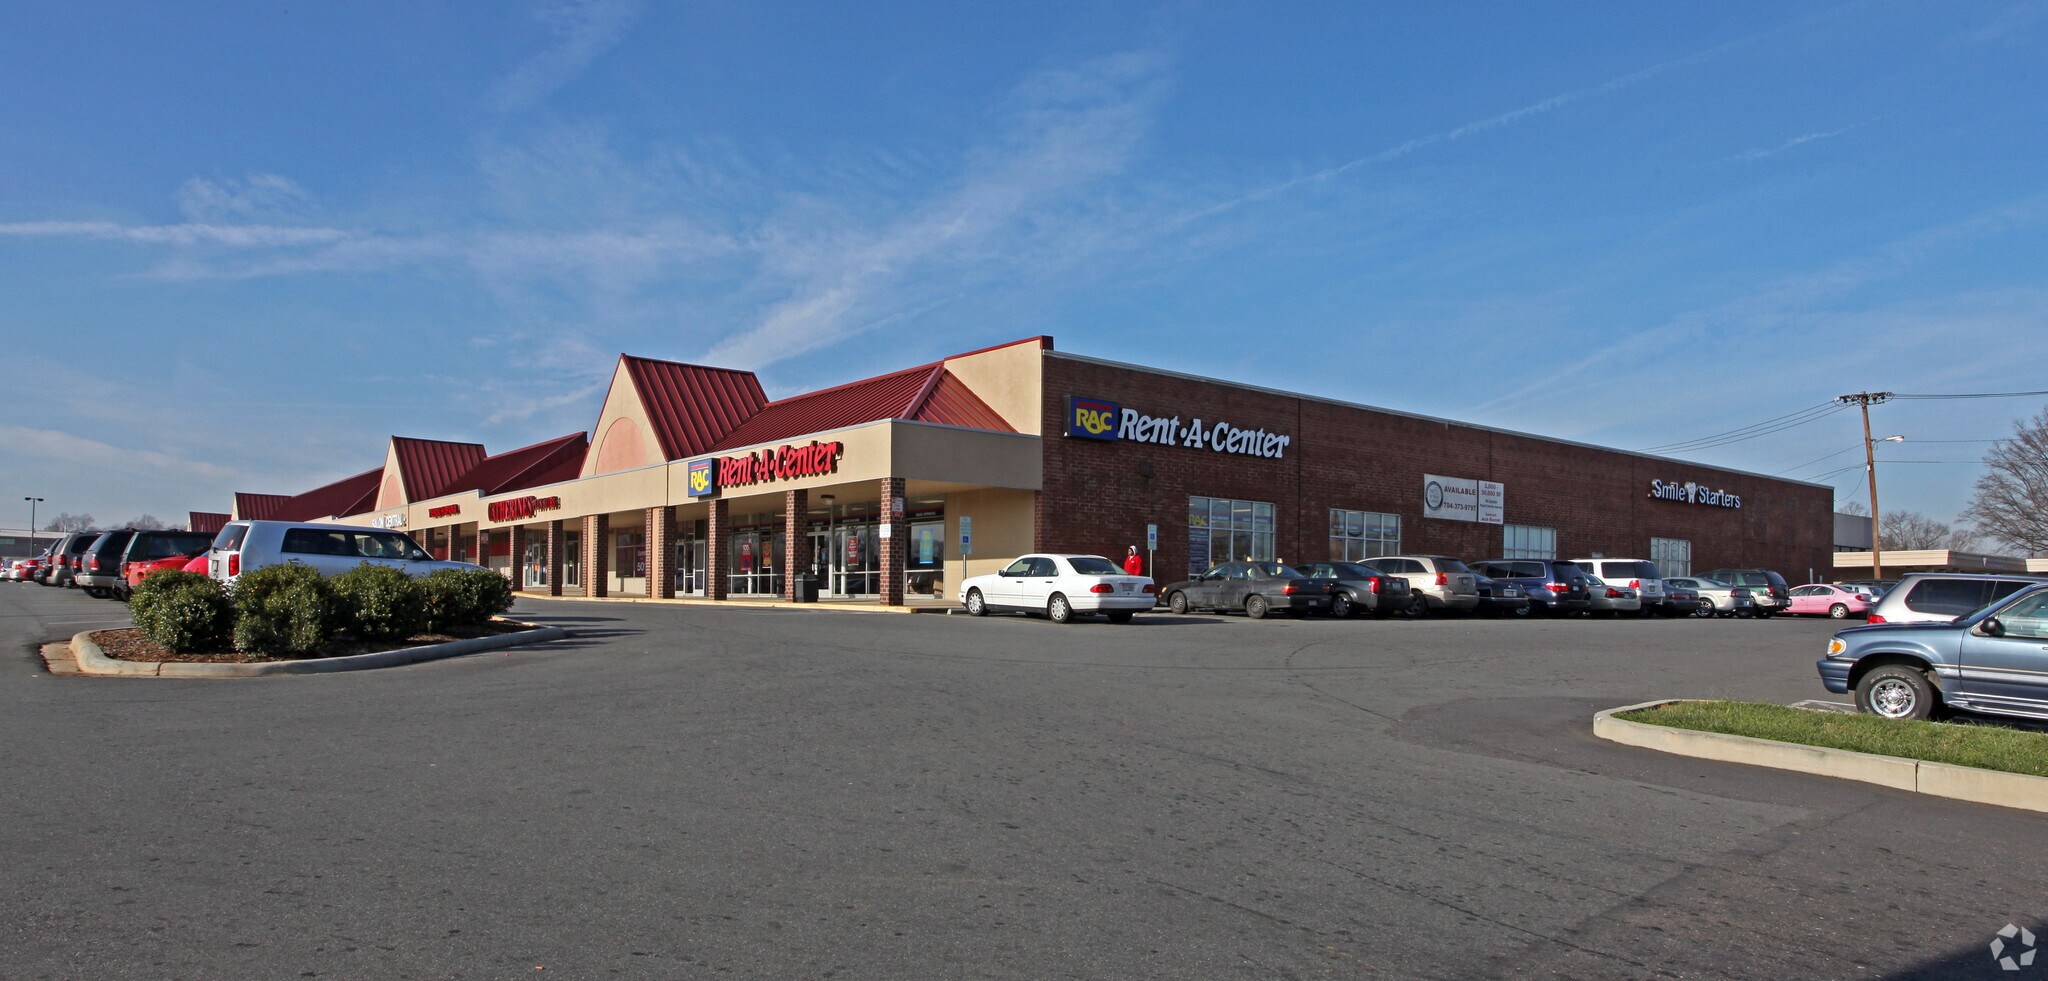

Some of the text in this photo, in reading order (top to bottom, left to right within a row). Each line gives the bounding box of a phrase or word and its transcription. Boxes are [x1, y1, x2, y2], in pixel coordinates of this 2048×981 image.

[1076, 408, 1112, 434] RAC
[690, 469, 709, 491] RAC
[1444, 486, 1476, 496] AVAILABLE
[1652, 478, 1741, 508] Smile Starters
